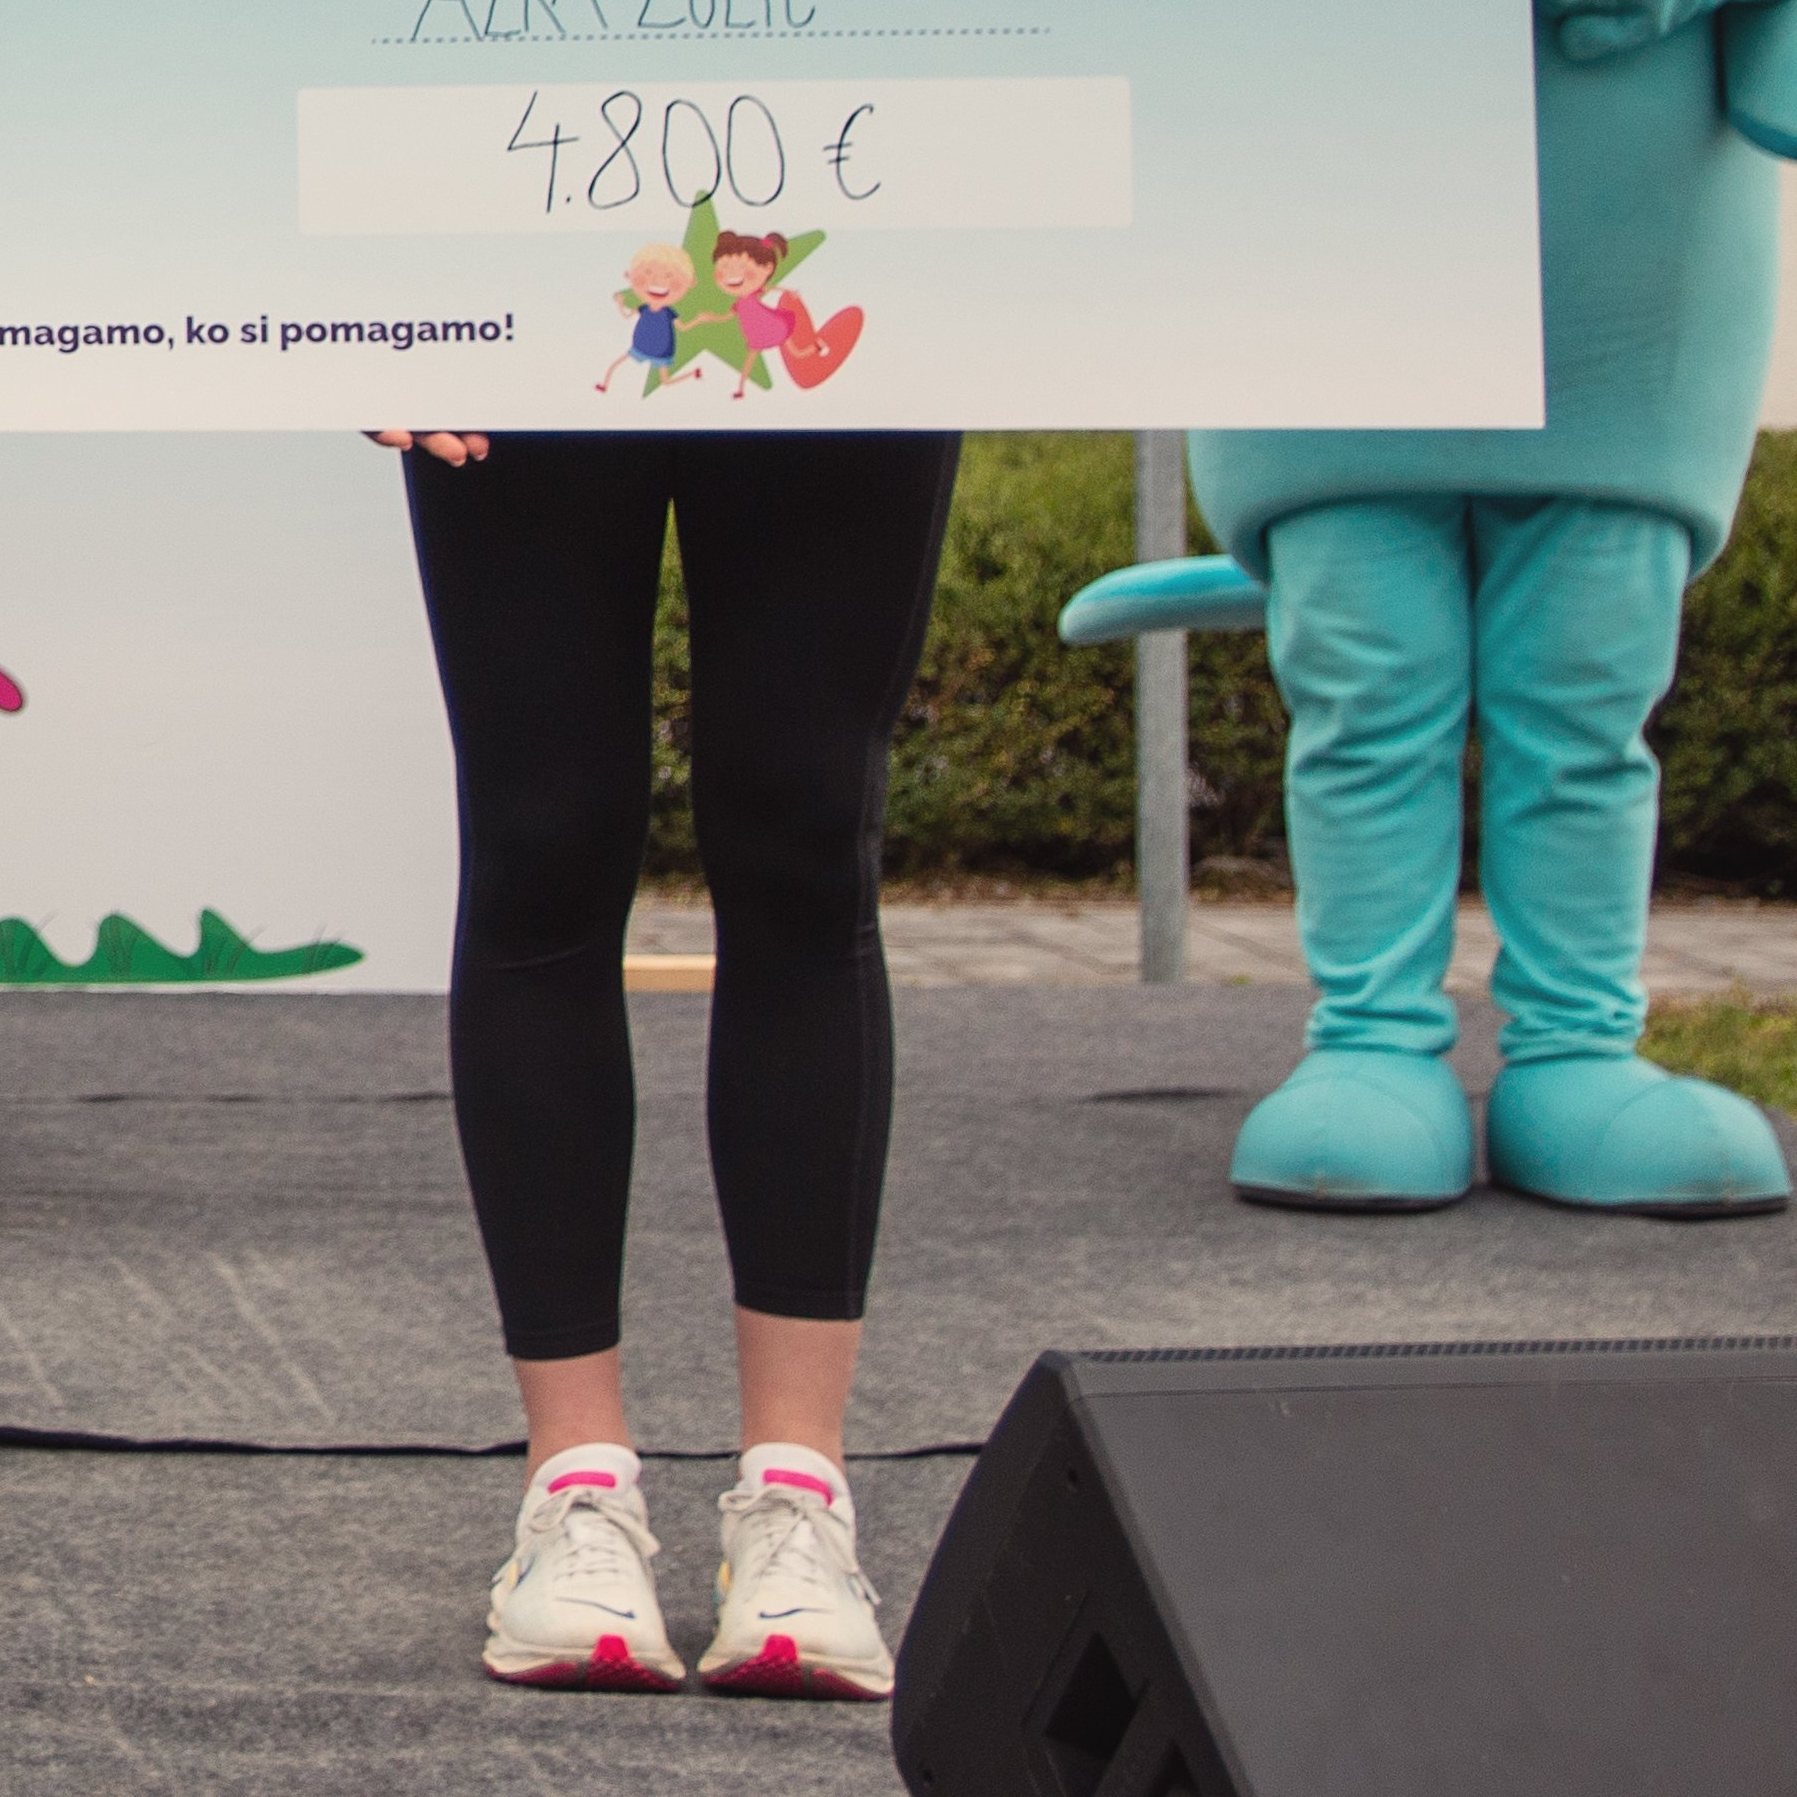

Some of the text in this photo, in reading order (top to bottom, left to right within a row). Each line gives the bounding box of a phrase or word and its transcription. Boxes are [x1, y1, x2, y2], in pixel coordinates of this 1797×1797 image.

[506, 89, 882, 214] 4.800 €
[185, 314, 232, 346] ko
[239, 313, 270, 346] si
[280, 311, 515, 353] pomagamo!
